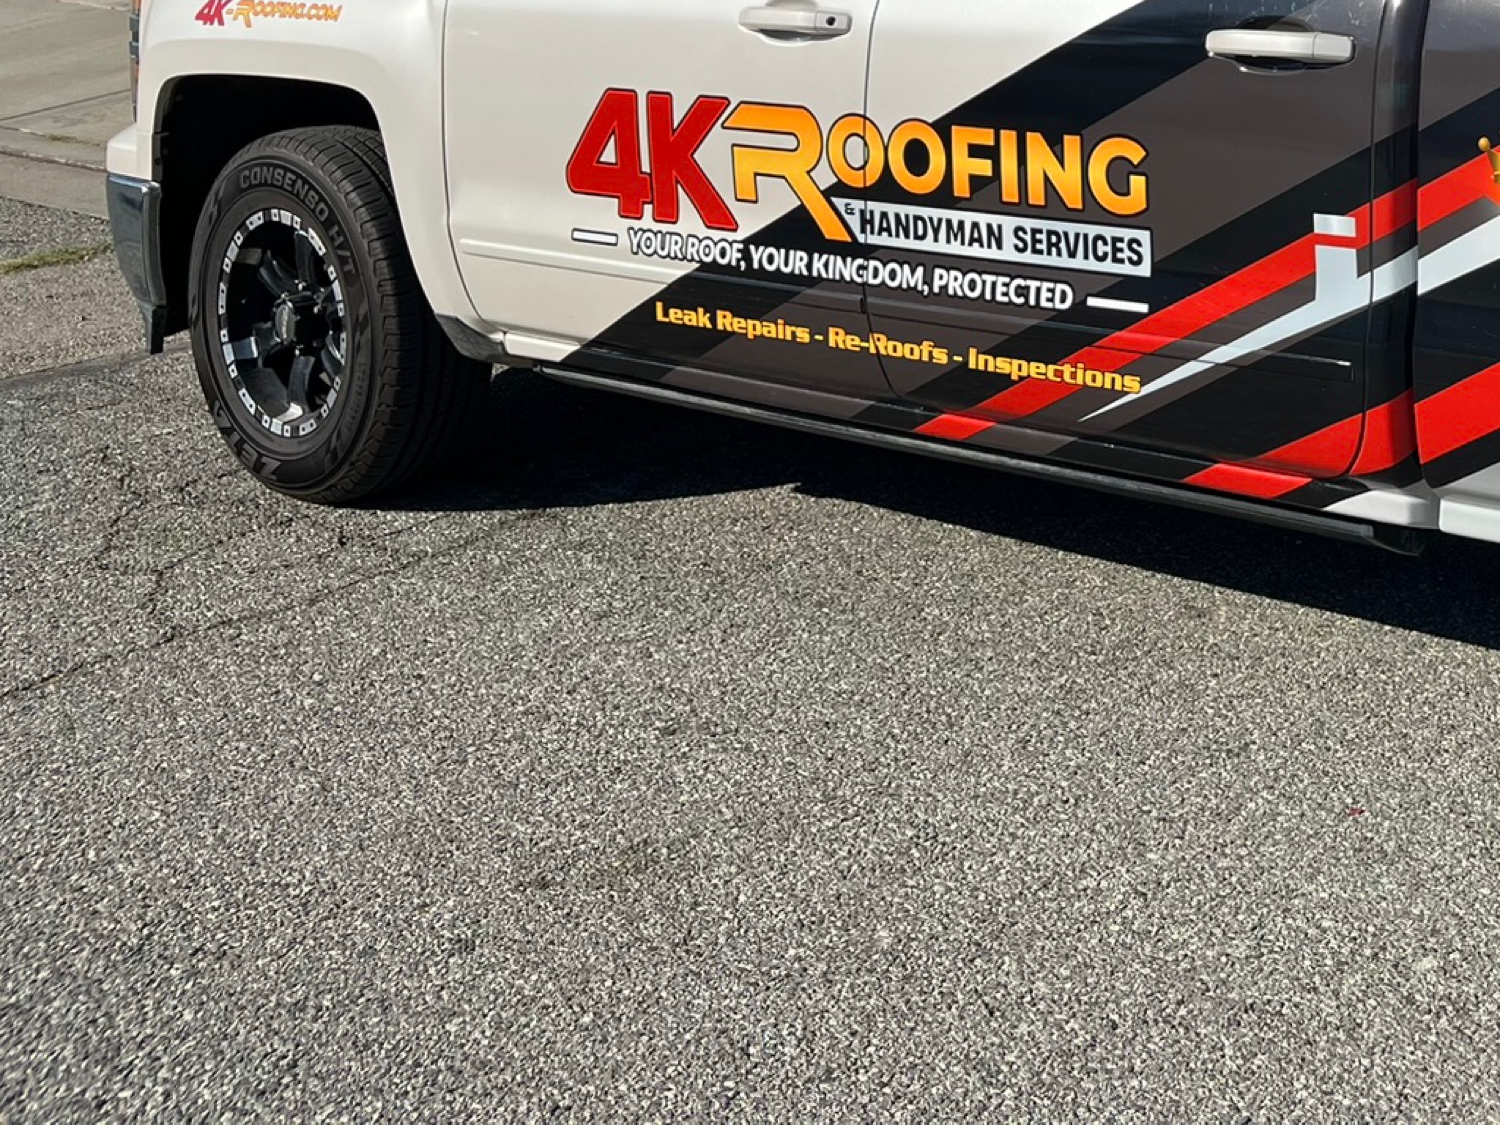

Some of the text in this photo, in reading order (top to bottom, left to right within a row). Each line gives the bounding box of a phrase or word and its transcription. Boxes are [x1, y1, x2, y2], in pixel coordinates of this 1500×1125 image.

[239, 165, 330, 223] CONSENSO
[566, 87, 1149, 243] 4K ROOFING
[627, 228, 1074, 311] YOUR ROOF, YOUR KINGDOM, PROTECTED
[858, 208, 1004, 252] HANDYMAN
[1012, 225, 1145, 267] SERVICES
[654, 300, 714, 330] Leak
[715, 308, 811, 345] Repairs
[827, 325, 950, 366] Re-Roofs
[967, 346, 1143, 396] Inspections
